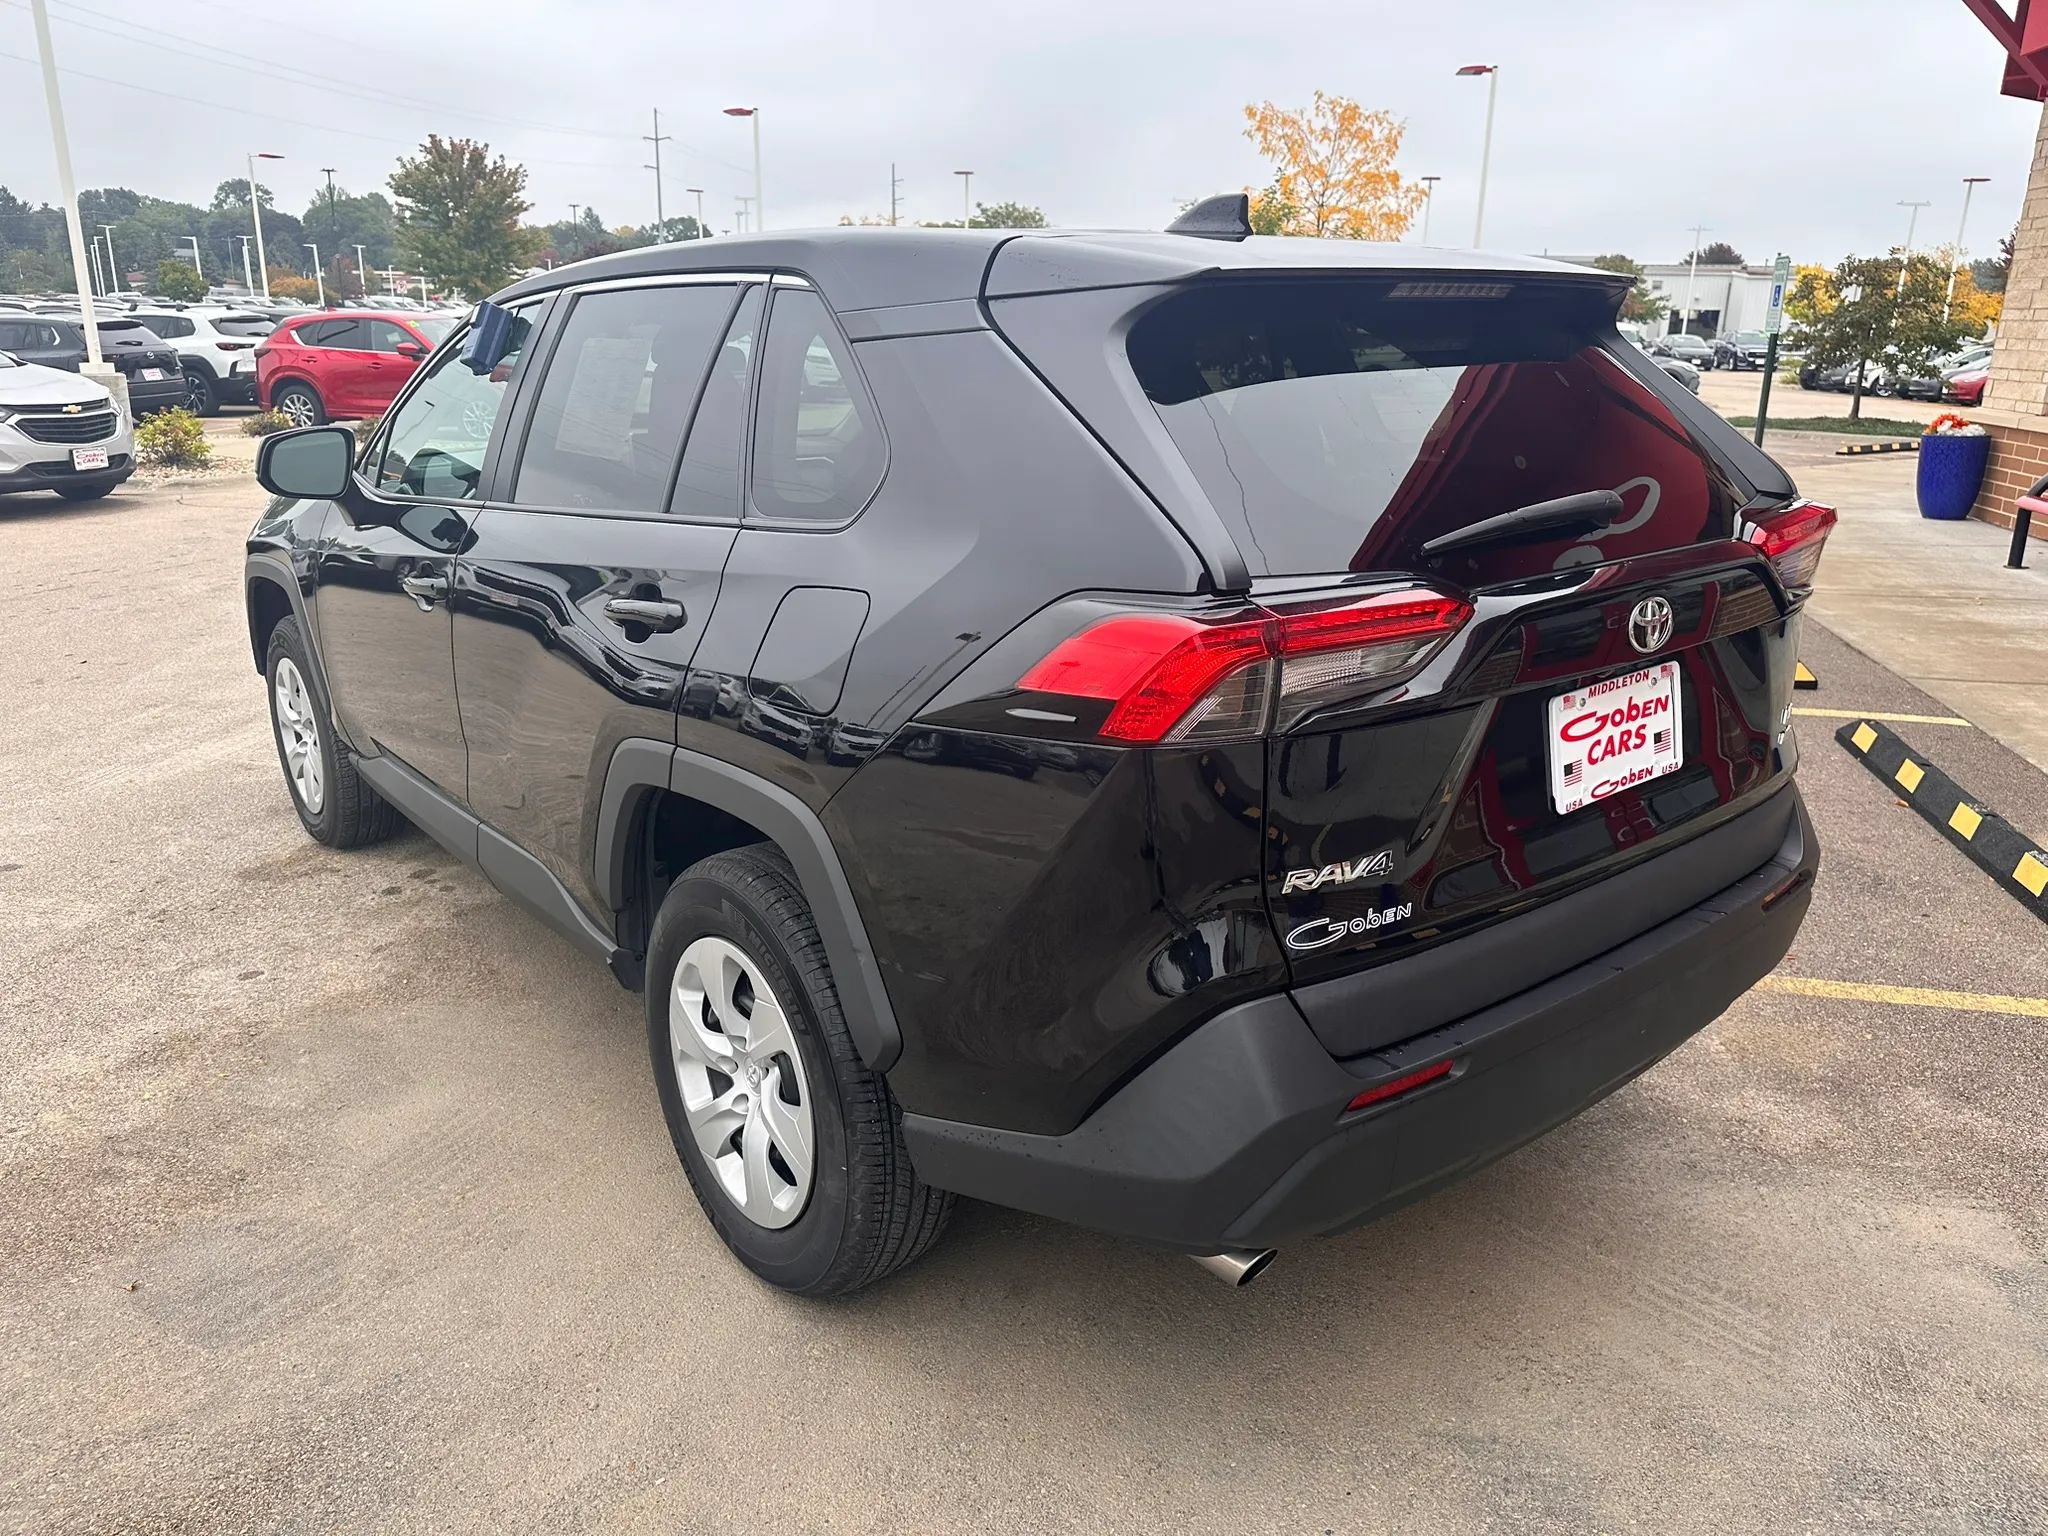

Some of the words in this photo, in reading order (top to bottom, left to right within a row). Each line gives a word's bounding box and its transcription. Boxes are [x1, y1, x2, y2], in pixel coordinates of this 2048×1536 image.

[1588, 670, 1650, 698] MIDDLETON
[1587, 723, 1647, 765] CARS
[1661, 762, 1679, 774] USA
[1565, 798, 1583, 812] USA
[1281, 850, 1394, 894] RAV4
[748, 929, 809, 1034] MICHELIN
